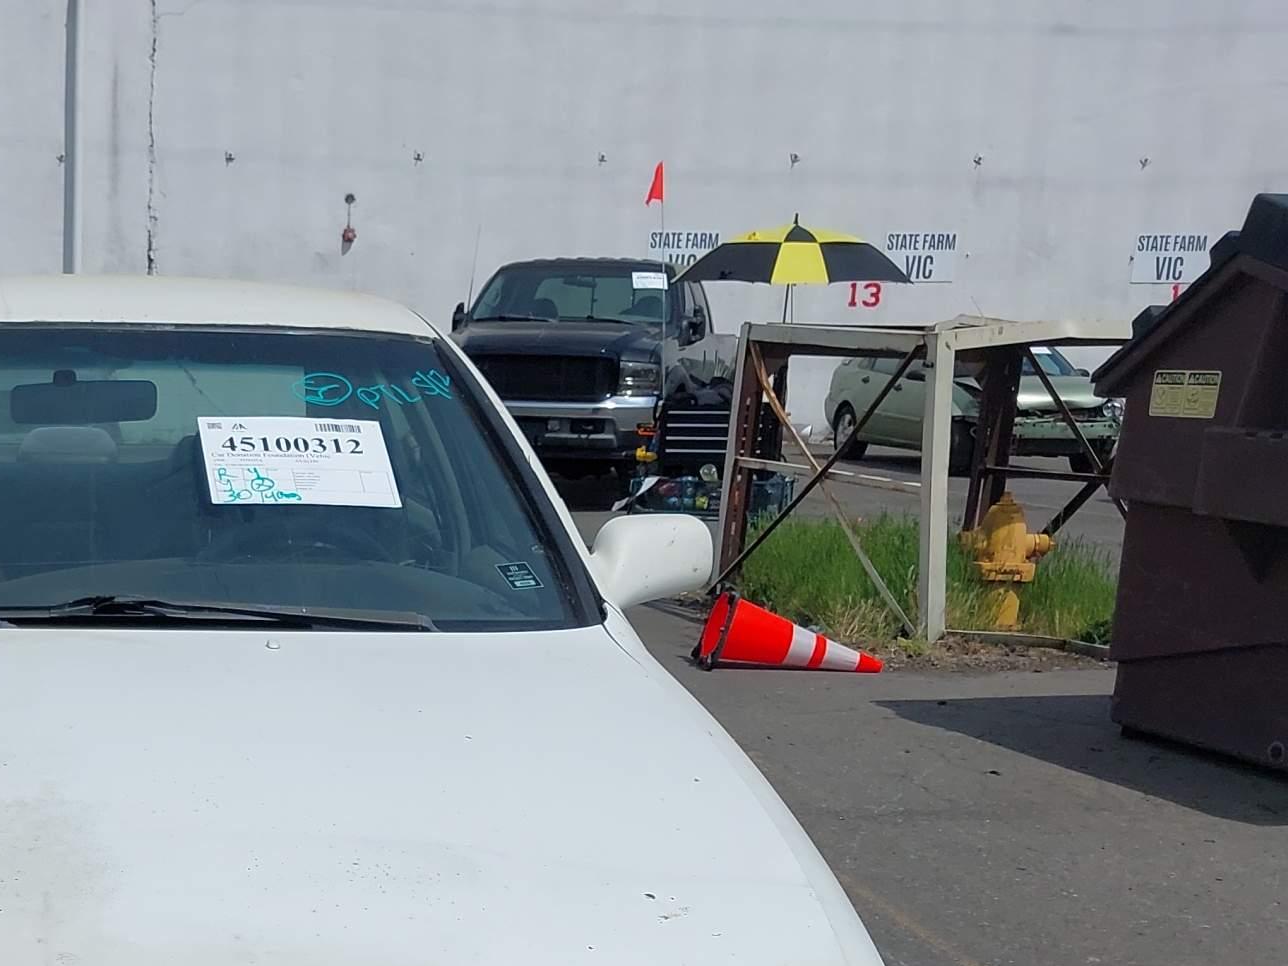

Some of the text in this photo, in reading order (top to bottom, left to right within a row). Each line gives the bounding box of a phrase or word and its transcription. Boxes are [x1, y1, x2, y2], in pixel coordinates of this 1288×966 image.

[650, 232, 719, 249] STATE FARM
[887, 233, 956, 250] STATE FARM
[1137, 235, 1207, 252] STATE FARM
[905, 255, 933, 280] VIC
[1155, 256, 1184, 281] VIC
[847, 282, 882, 308] 13
[221, 435, 364, 455] 45100312
